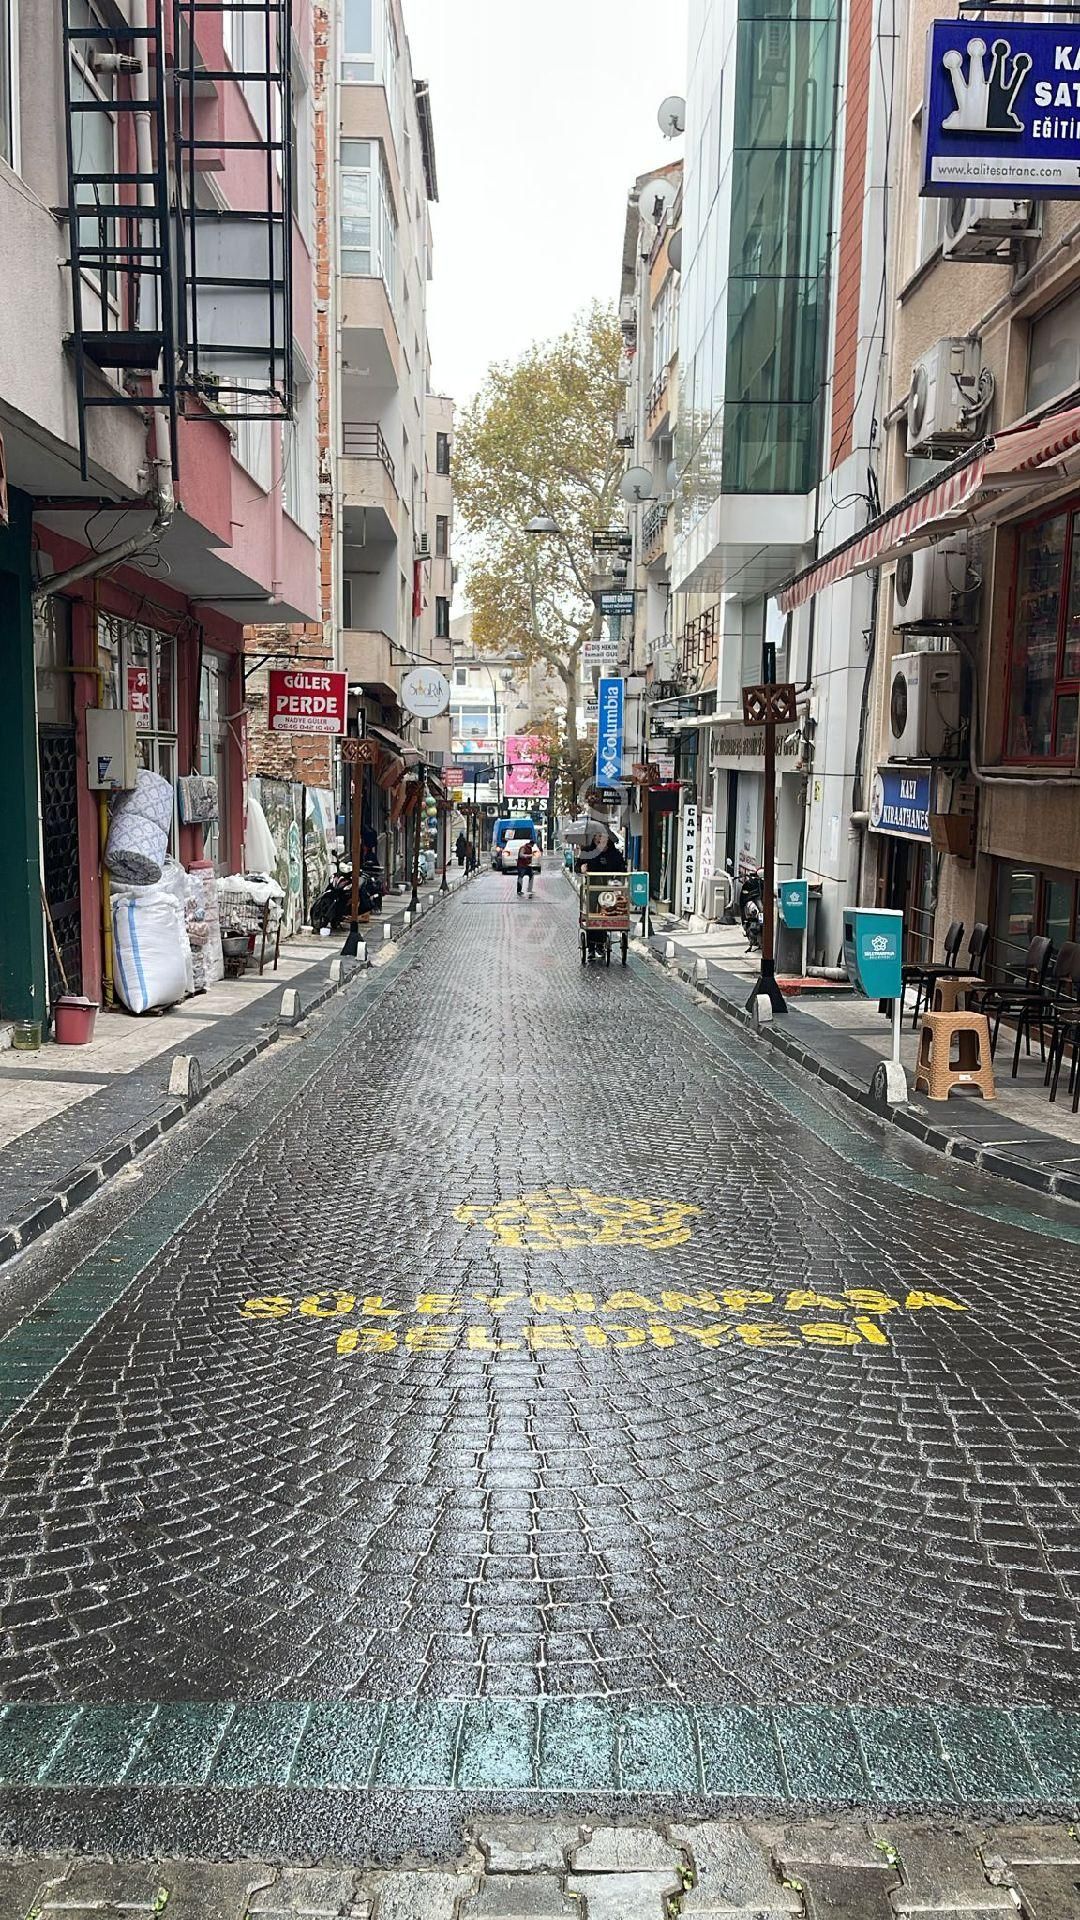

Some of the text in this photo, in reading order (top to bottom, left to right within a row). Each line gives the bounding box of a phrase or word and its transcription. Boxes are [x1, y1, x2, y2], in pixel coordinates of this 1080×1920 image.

[938, 162, 1062, 177] www.kalitesatranc.com
[284, 672, 331, 692] GÜLER
[277, 695, 338, 715] PERDE
[602, 686, 619, 760] Columbia
[900, 779, 917, 800] KAYI
[507, 798, 548, 811] LEP'S
[686, 807, 696, 837] CAN
[684, 844, 695, 905] PASAJI
[336, 1315, 889, 1353] BELEDİYESİ
